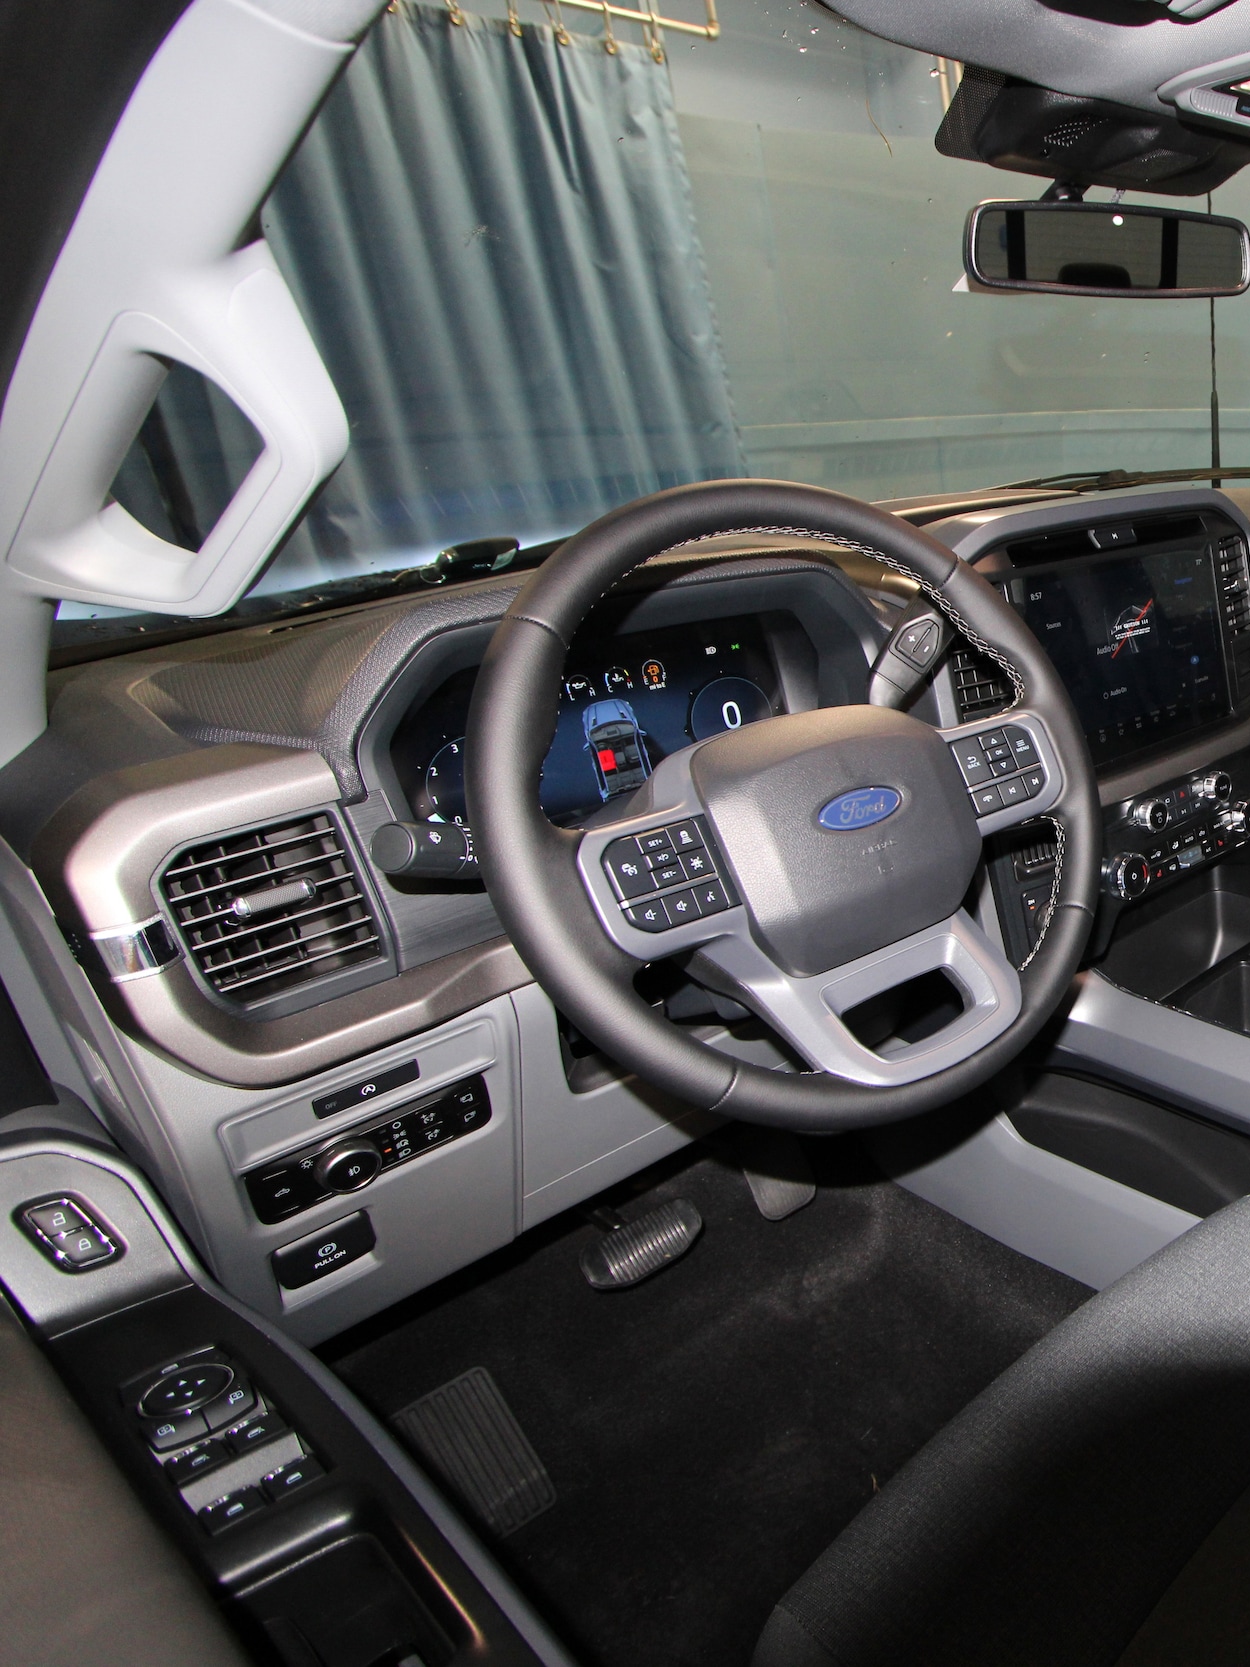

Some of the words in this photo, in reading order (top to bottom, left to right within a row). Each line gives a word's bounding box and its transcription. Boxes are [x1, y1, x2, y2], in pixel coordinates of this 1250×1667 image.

[1030, 591, 1042, 601] 8:57
[1096, 645, 1111, 655] Audio
[722, 701, 742, 729] 0
[451, 744, 459, 753] 3
[1016, 745, 1030, 753] MENU
[967, 761, 981, 770] BACK
[430, 767, 438, 776] 2
[432, 795, 438, 804] 1
[840, 795, 886, 824] Ford
[325, 1101, 337, 1110] OFF
[314, 1257, 334, 1269] PULL
[333, 1249, 347, 1259] ON
